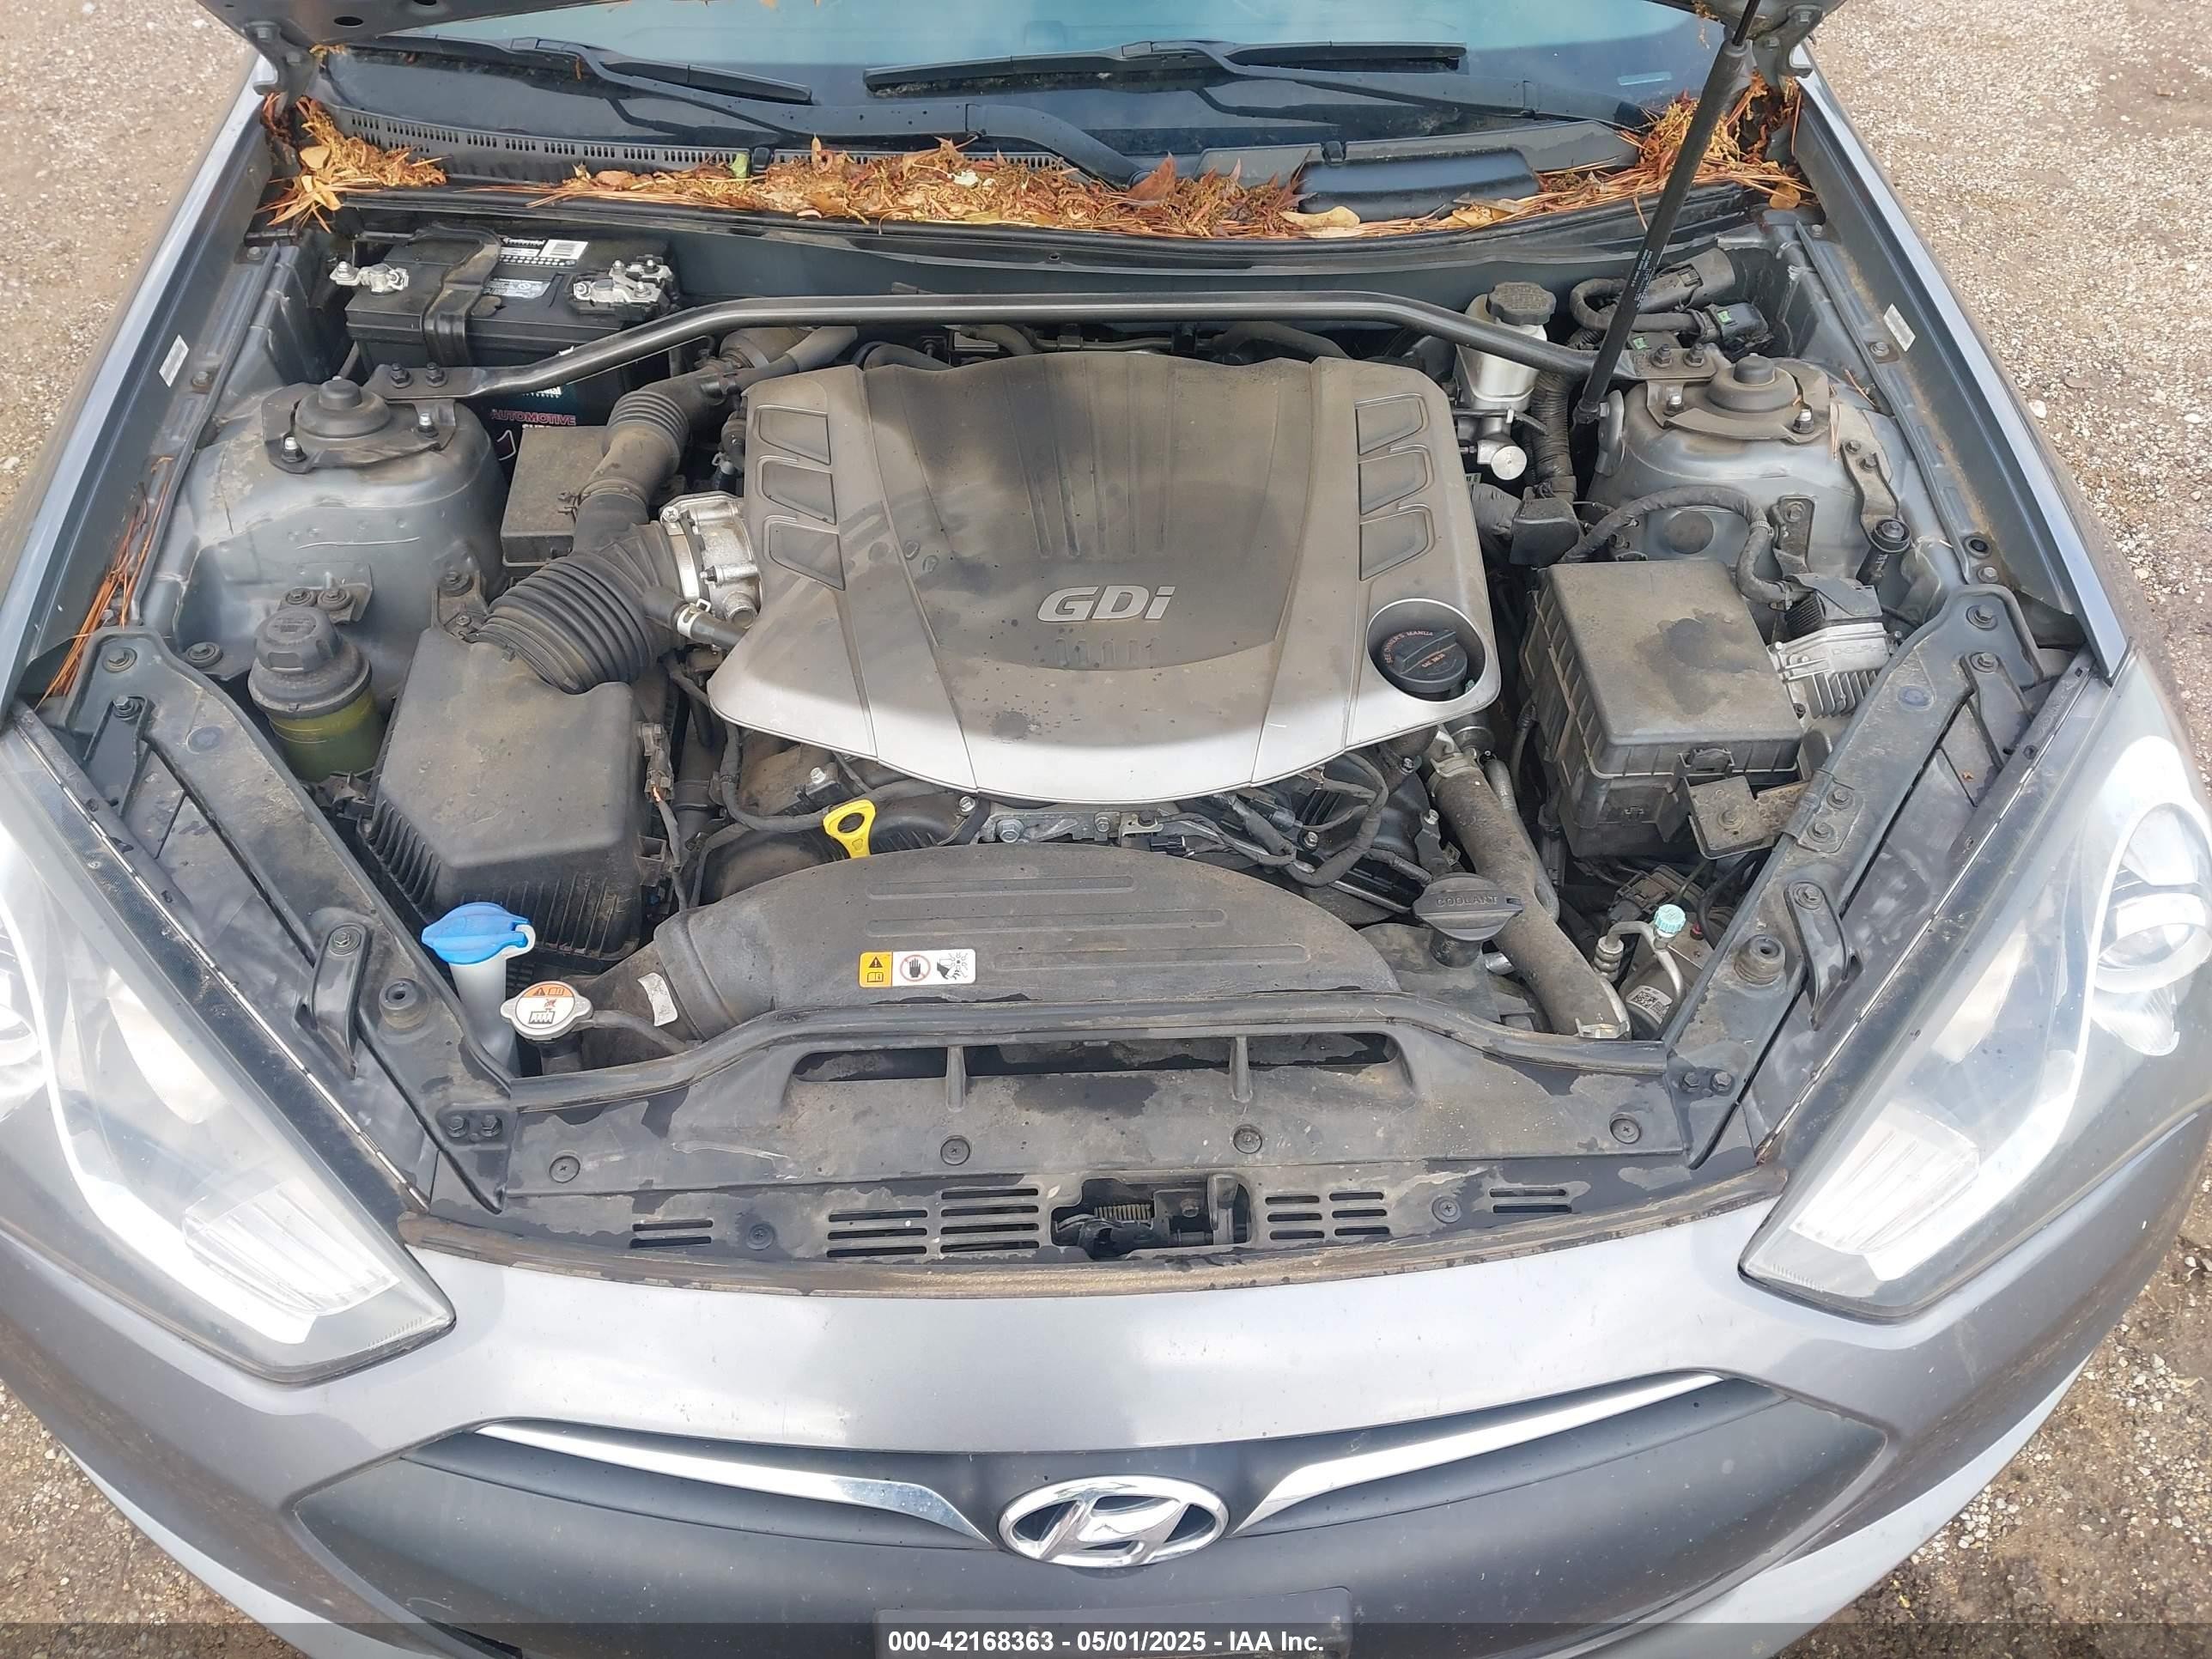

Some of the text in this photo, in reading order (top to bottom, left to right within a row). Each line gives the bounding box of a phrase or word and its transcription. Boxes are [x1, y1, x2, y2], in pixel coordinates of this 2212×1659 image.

[490, 409, 576, 426] AUTOMOTIVE
[1036, 584, 1176, 623] GDi
[1436, 896, 1498, 908] COOLANT
